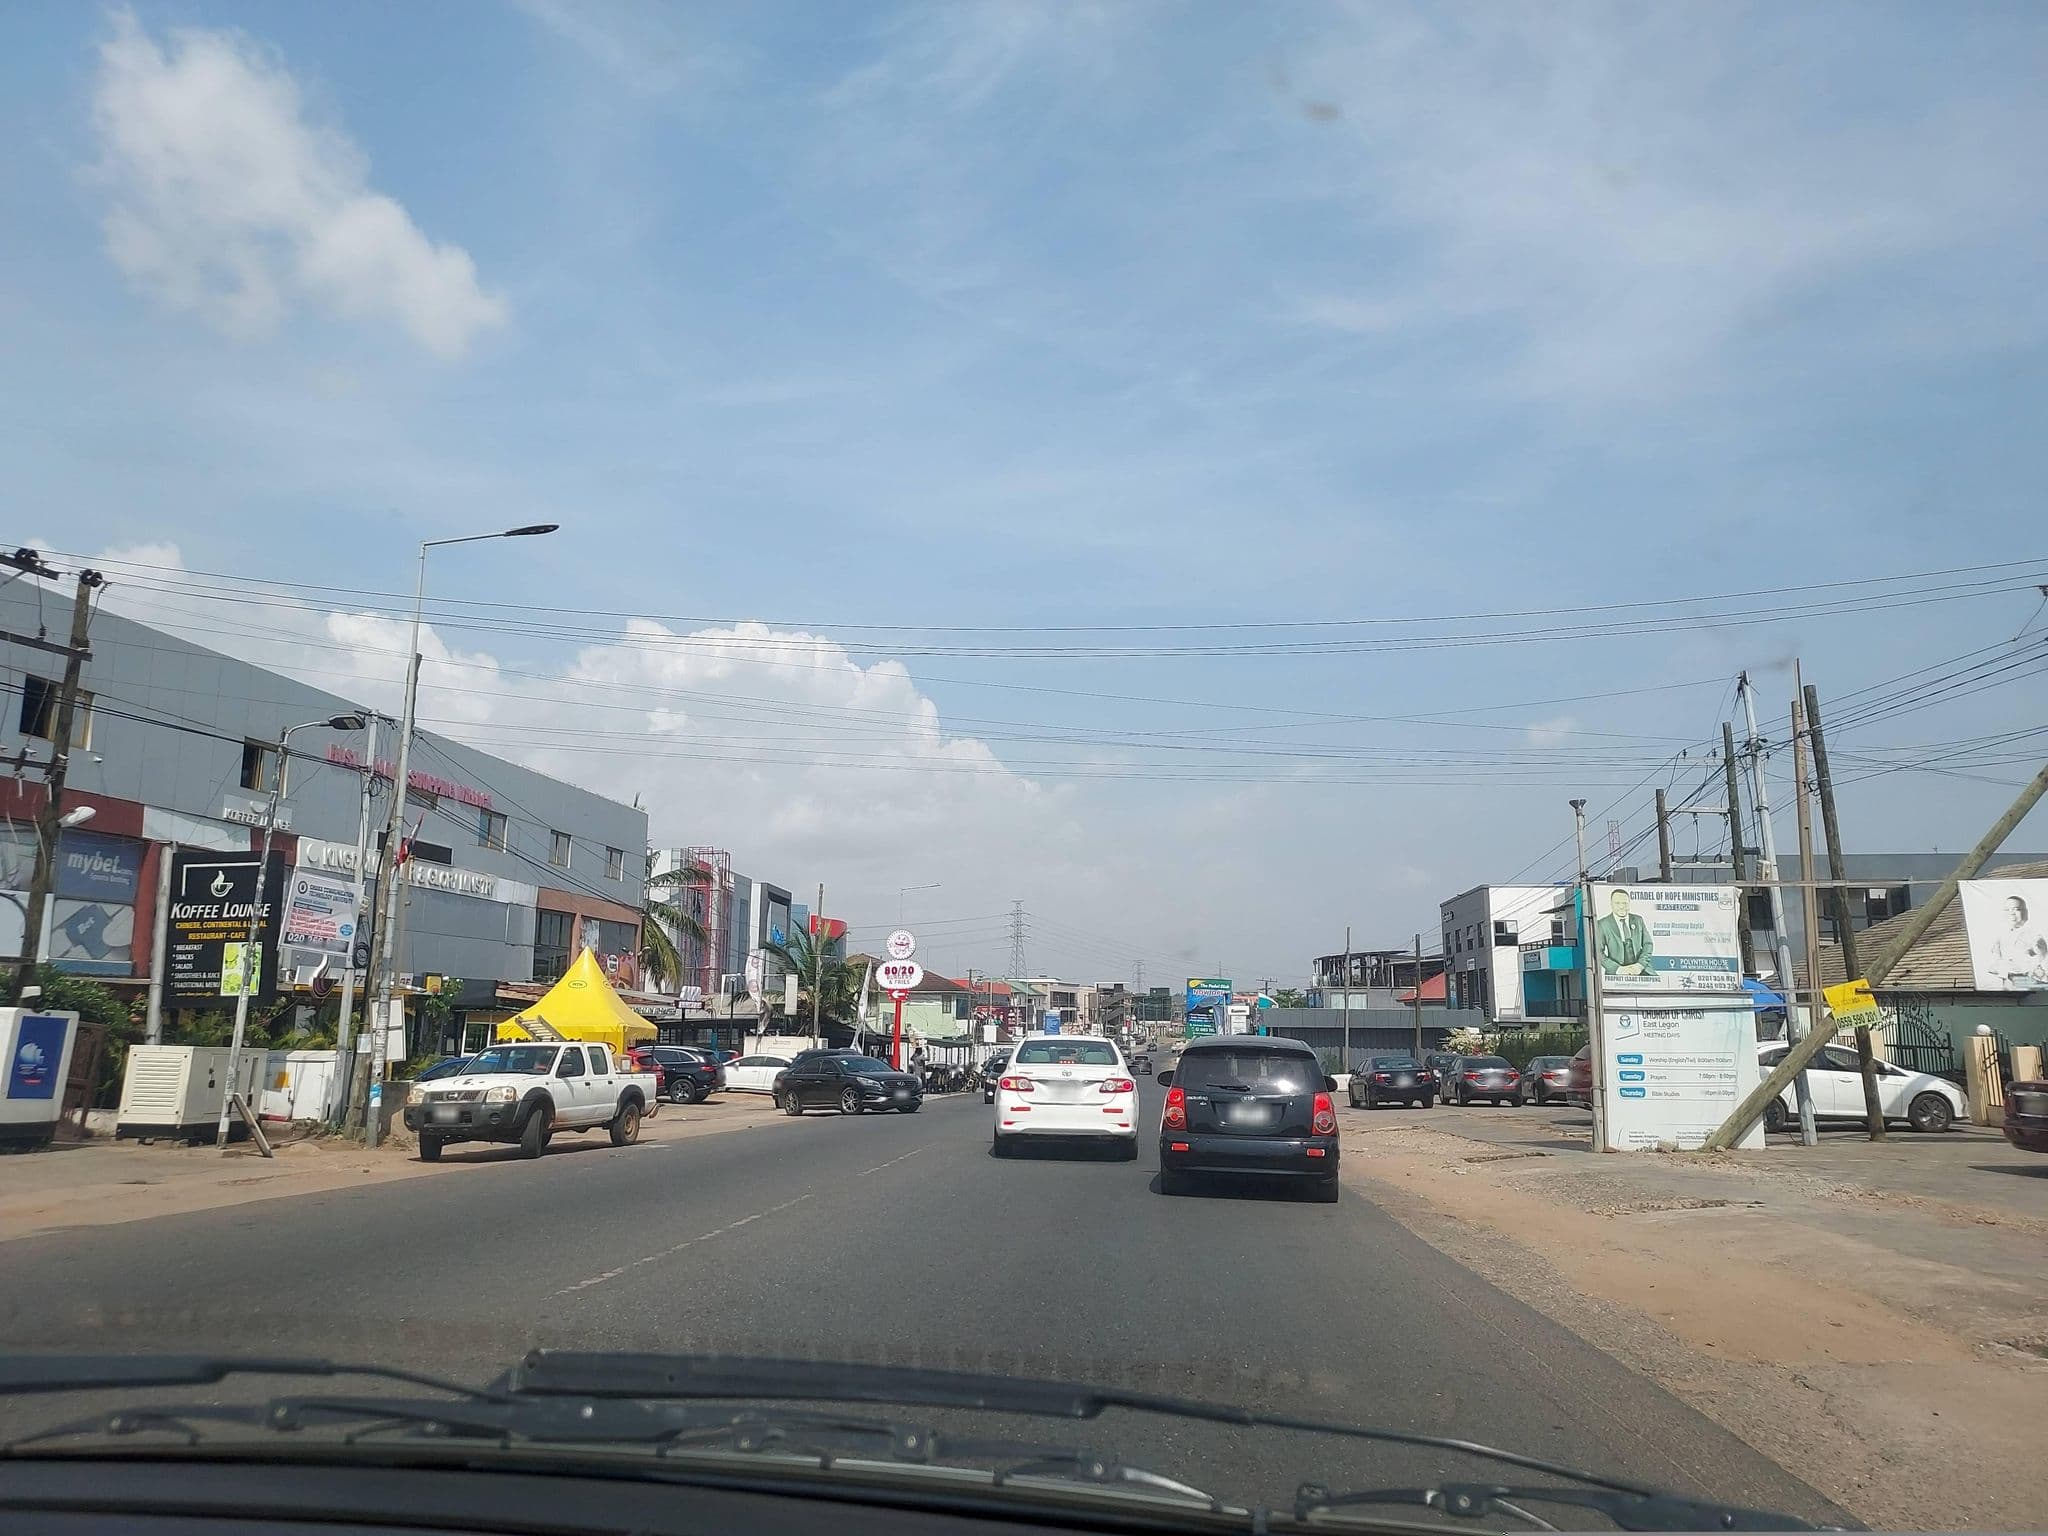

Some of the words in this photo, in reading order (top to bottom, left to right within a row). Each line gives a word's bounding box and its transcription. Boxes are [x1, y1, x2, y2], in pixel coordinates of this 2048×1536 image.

[224, 807, 258, 825] KOFFEE
[1630, 891, 1655, 900] CITADEL
[1656, 891, 1663, 900] OF
[1665, 892, 1680, 900] HOPE
[1682, 892, 1719, 901] MINISTRIES
[171, 902, 220, 919] KOFFEE
[203, 920, 242, 929] CONTINENTAL
[188, 931, 227, 940] RESTAURANT
[230, 931, 247, 939] CAFE
[287, 932, 305, 942] 020
[884, 965, 915, 976] 80/20
[1642, 1010, 1669, 1019] CHURCH
[1671, 1010, 1680, 1019] OF
[1681, 1009, 1705, 1019] CHRIST
[1659, 1021, 1679, 1029] Legon
[1622, 1071, 1642, 1079] Tuesday
[1649, 1073, 1667, 1081] Prayers
[1621, 1089, 1644, 1097] Thursday
